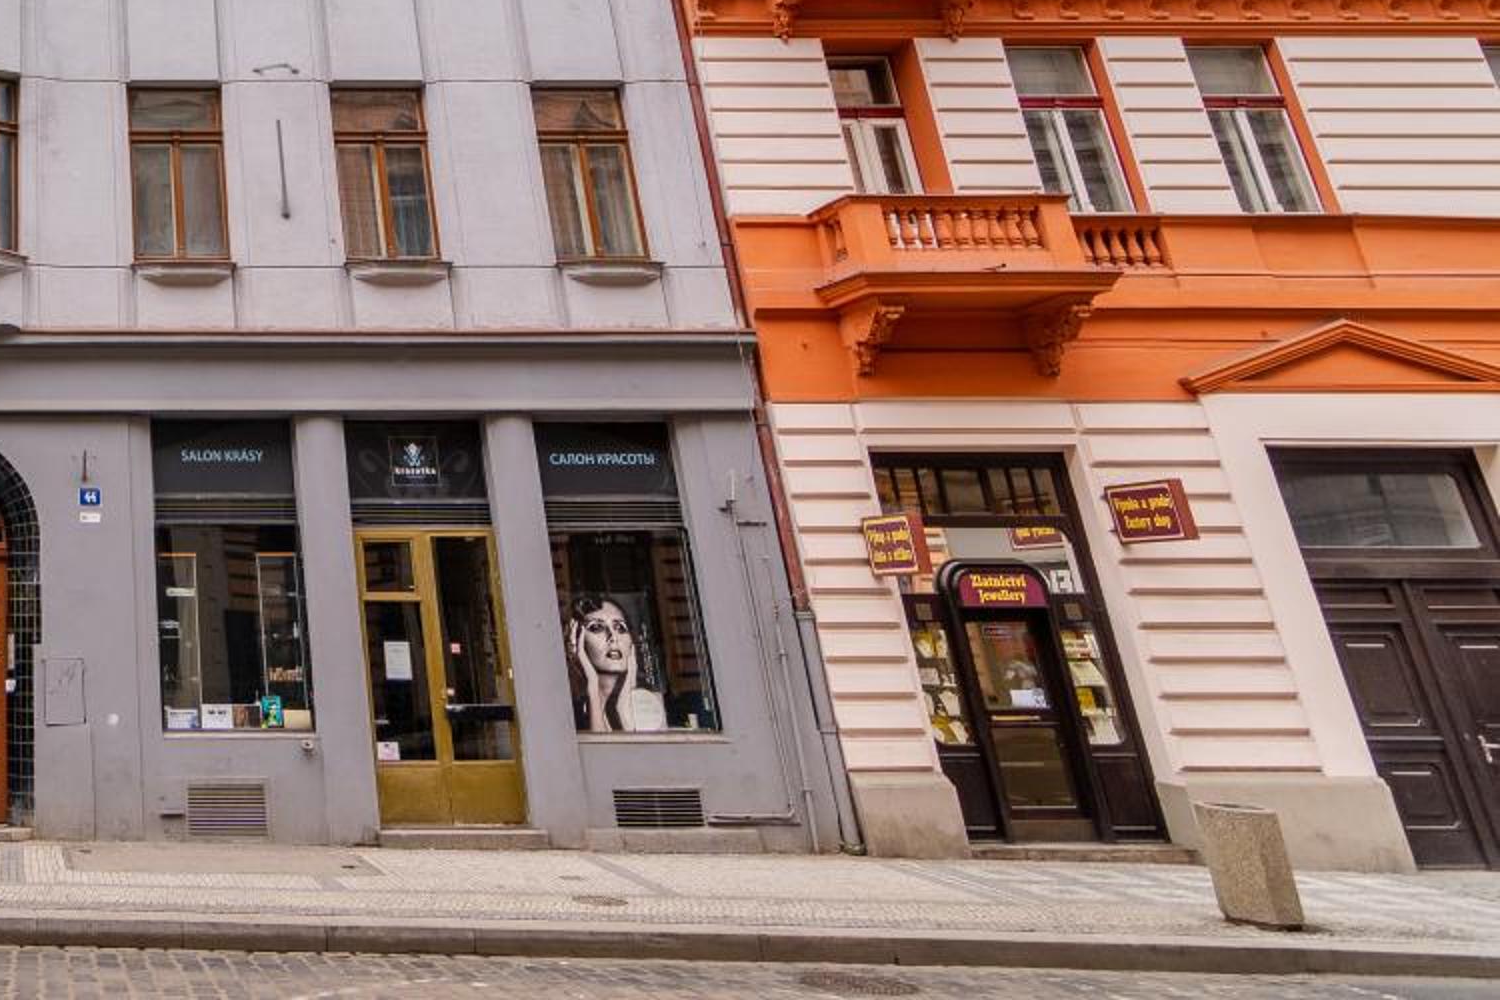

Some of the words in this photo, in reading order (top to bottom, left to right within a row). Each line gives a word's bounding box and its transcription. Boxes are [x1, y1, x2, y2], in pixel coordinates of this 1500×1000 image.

[181, 449, 221, 461] SALON
[549, 453, 595, 465] САЛОН
[597, 453, 655, 465] КРАСОТЫ
